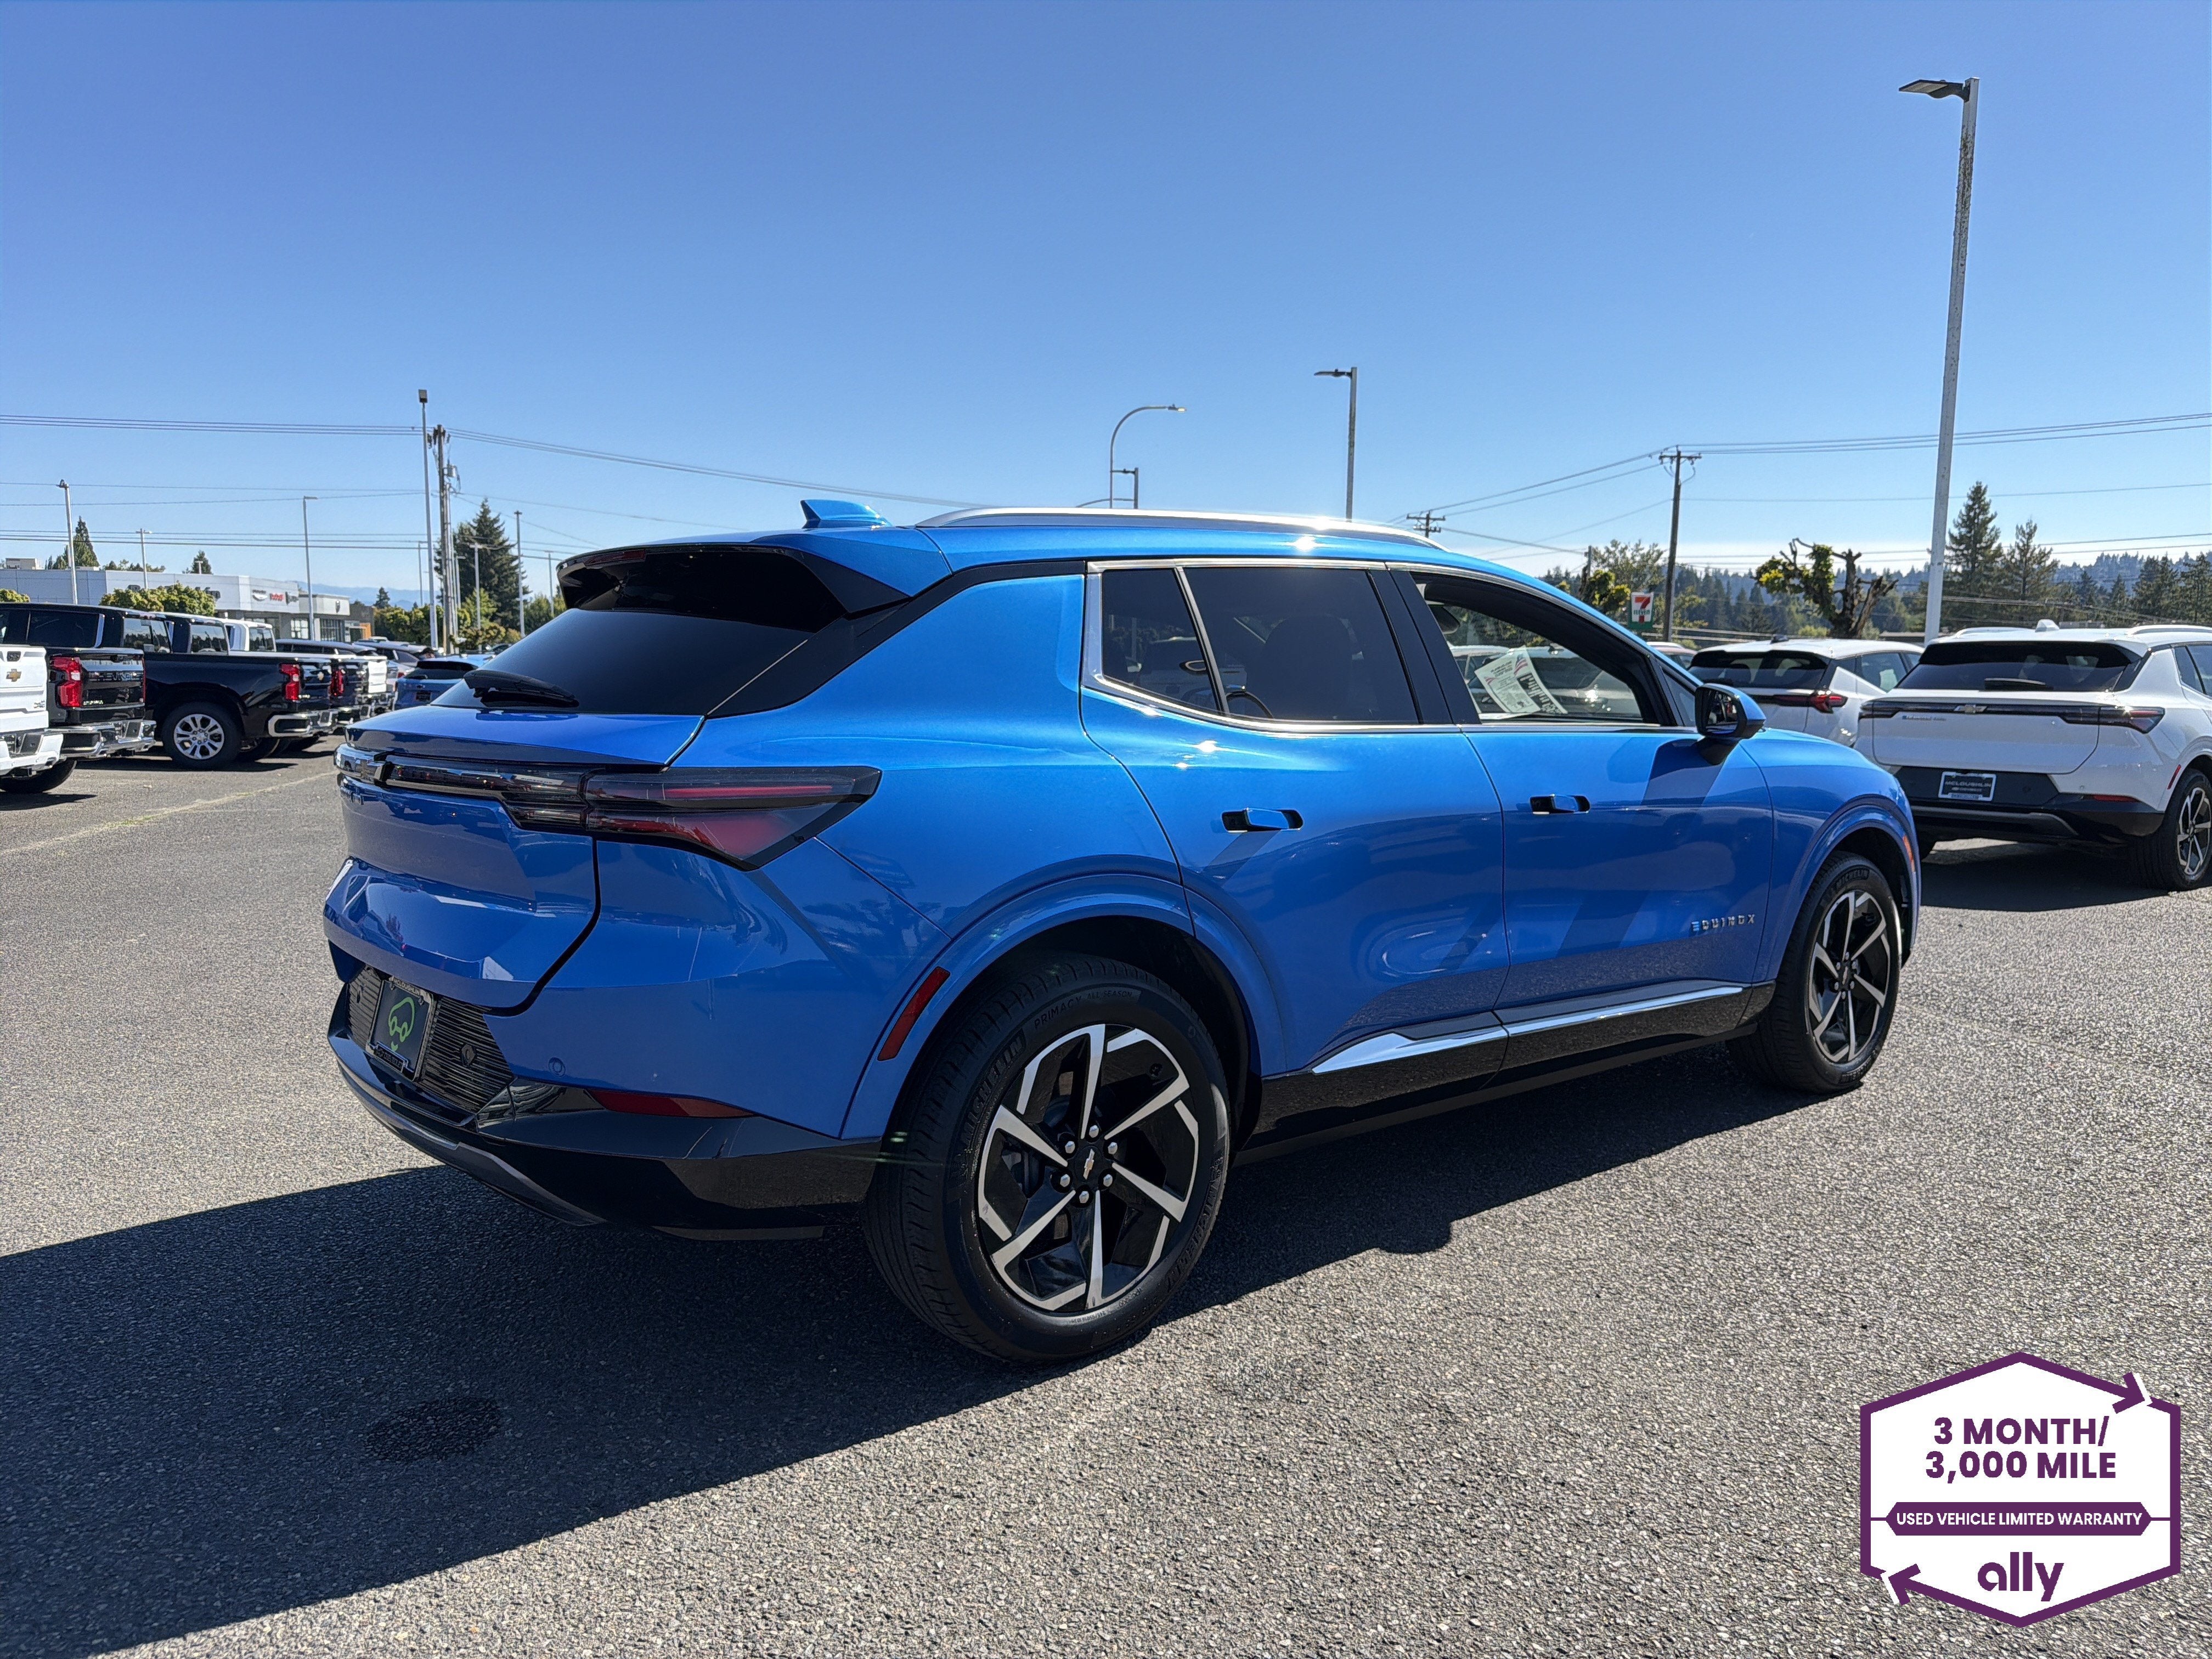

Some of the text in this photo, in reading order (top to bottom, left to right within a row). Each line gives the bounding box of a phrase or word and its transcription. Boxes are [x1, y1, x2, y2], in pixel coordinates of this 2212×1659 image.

[1691, 914, 1755, 932] EQUINOX
[393, 977, 421, 996] MCLOUGHLIN
[1034, 995, 1082, 1029] PRIMACY
[960, 1035, 1024, 1149] MICHELIN
